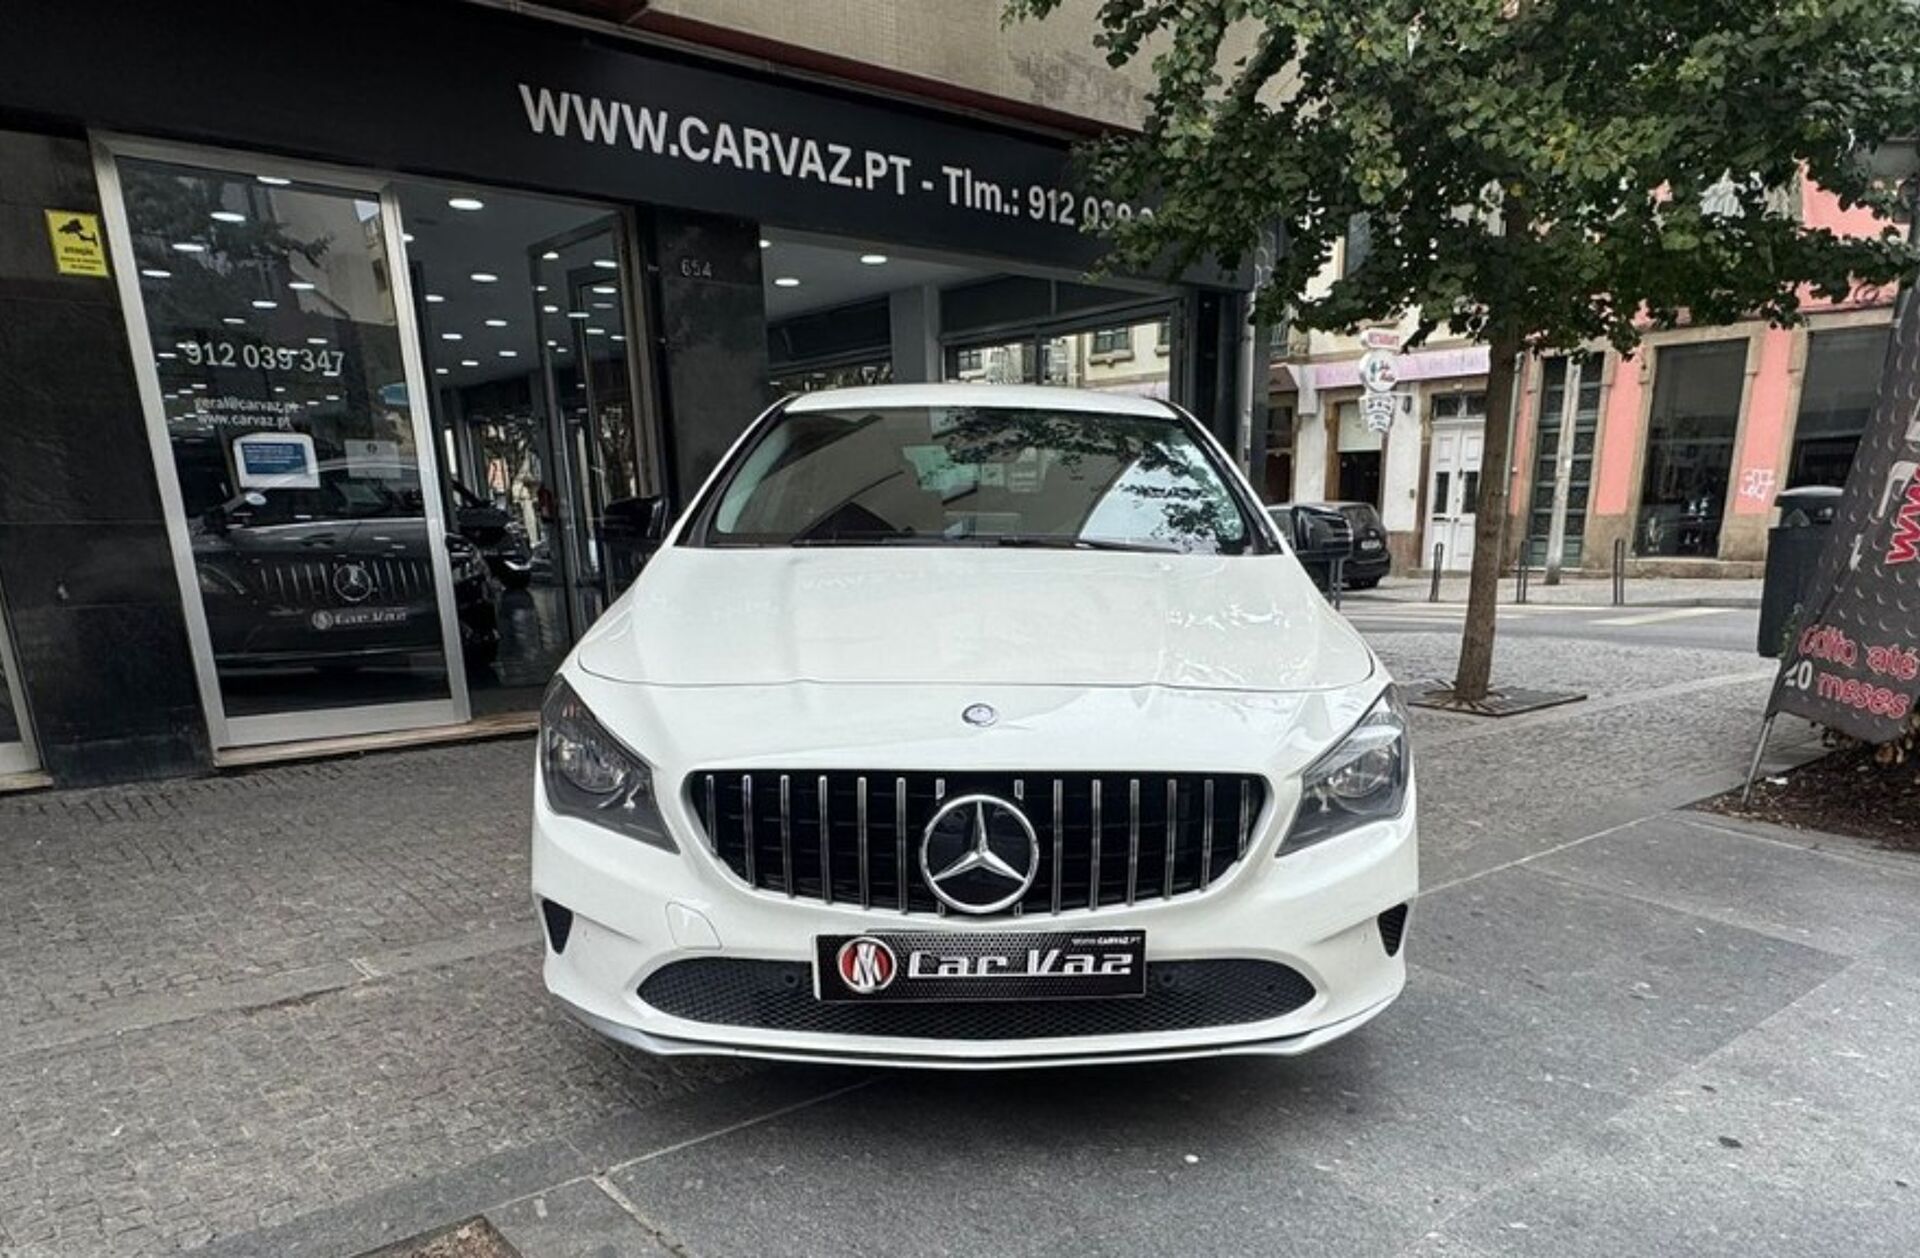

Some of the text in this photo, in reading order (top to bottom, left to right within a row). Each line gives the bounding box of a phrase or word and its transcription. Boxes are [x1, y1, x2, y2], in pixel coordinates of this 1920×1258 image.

[518, 83, 912, 196] WWW.CARVAZ.PT
[942, 165, 1020, 217] Tlm.:
[1028, 185, 1076, 227] 912
[185, 339, 345, 375] 912 039 347
[196, 413, 293, 431] www.carvaz.pt
[1818, 671, 1911, 719] meses
[907, 949, 1134, 979] Car Vaz
